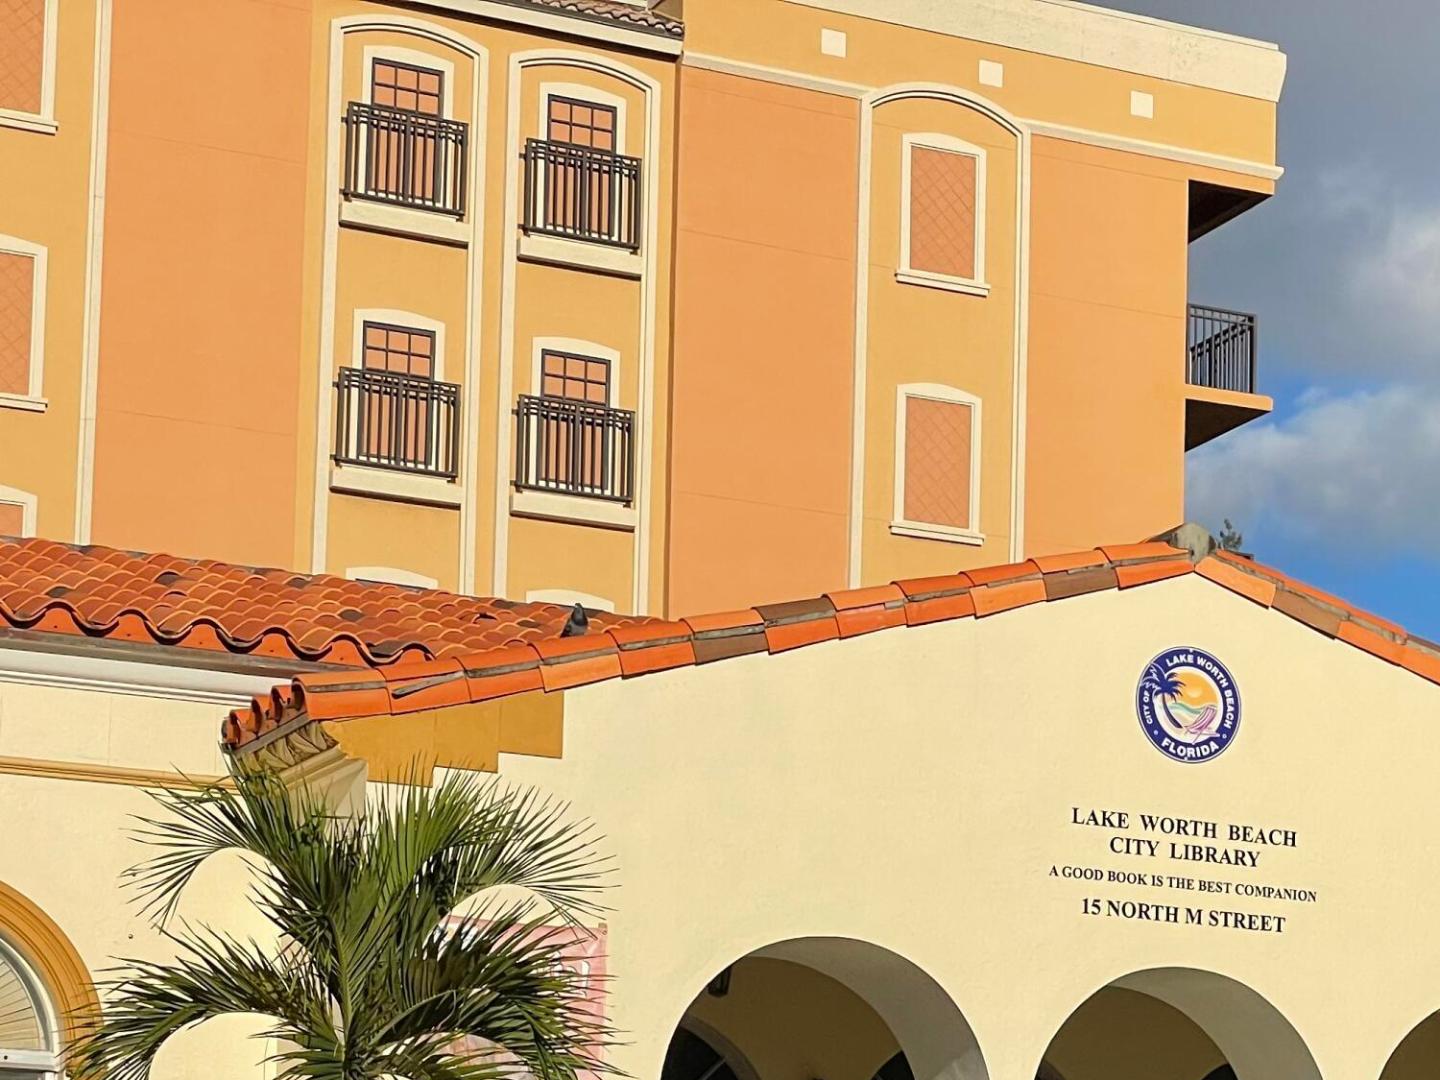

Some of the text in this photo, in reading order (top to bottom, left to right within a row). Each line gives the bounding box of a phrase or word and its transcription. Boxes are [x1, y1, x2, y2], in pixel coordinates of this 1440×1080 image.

[1143, 654, 1235, 729] CITY OF LAKE WORTH BEACH
[1161, 737, 1219, 758] FLORIDA
[1071, 807, 1297, 848] LAKE WORTH BEACH
[1109, 836, 1260, 868] CITY LIBRARY
[1048, 865, 1317, 903] A GOOD BOOK IS THE BEST COMPANION
[1081, 897, 1286, 933] 15 NORTH M STREET
